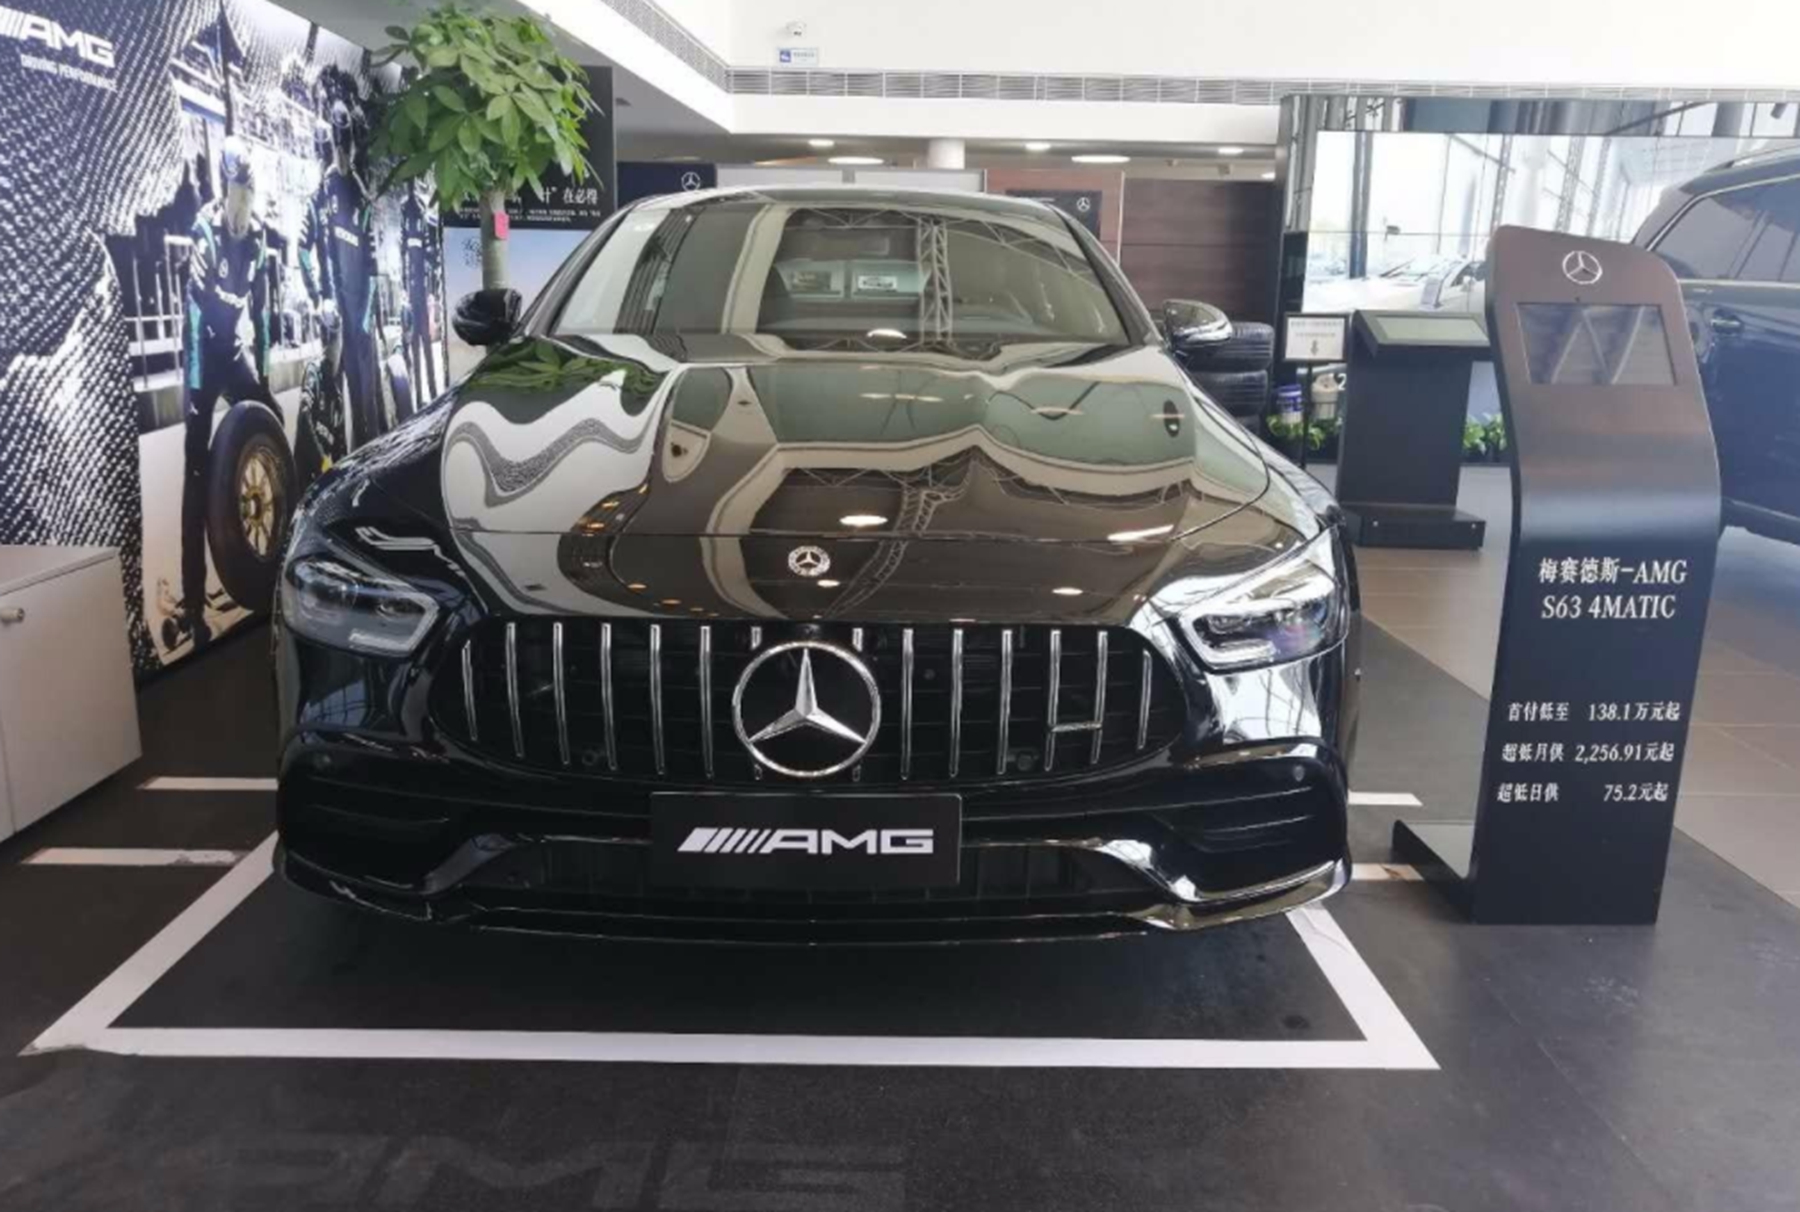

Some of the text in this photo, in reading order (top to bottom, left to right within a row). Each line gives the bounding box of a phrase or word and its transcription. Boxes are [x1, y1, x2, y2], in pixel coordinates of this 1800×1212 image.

[20, 12, 115, 69] AMG
[1538, 556, 1688, 585] 梅赛德斯-AMG
[1541, 595, 1676, 619] S63 4MATIC
[1508, 701, 1680, 722] 首付低至 138.1万元起
[1502, 742, 1675, 764] 超低月供 2,256.91元起
[1497, 782, 1669, 803] 超低日供 75.2元起
[758, 828, 934, 855] AMG
